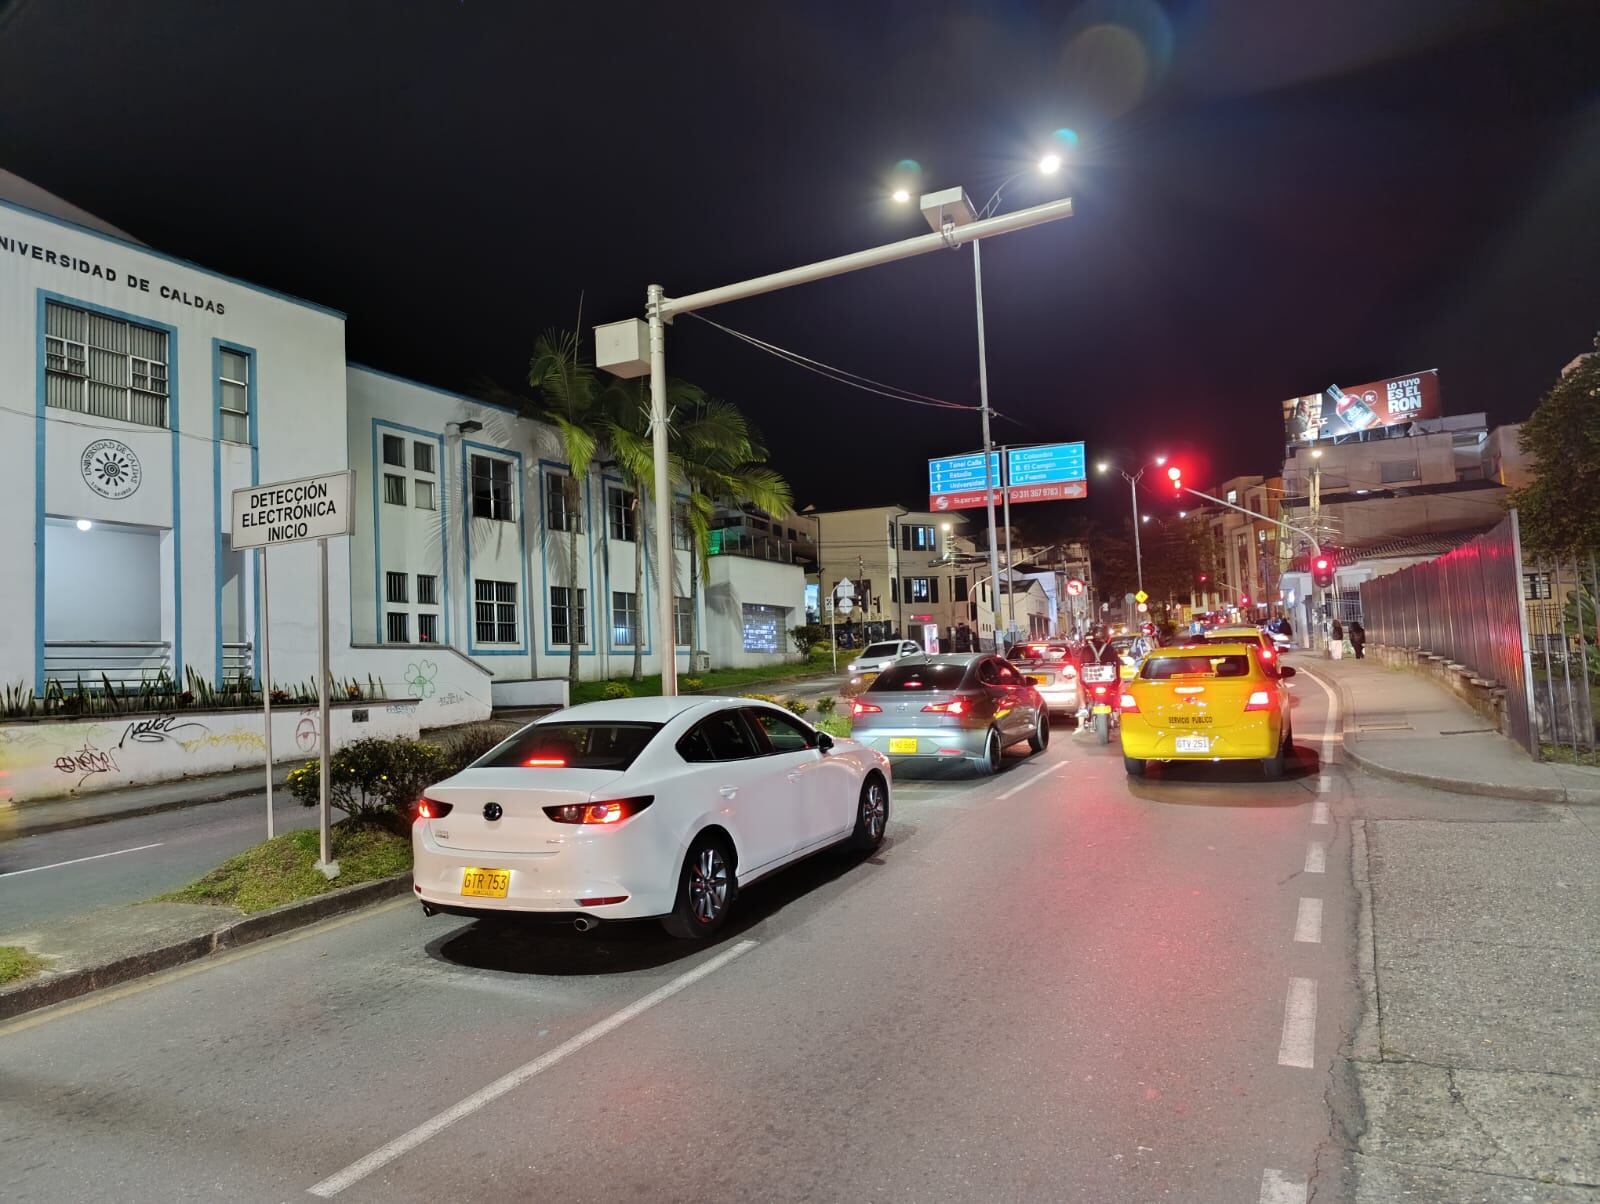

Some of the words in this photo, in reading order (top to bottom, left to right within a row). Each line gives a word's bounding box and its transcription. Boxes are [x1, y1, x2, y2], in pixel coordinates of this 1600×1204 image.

[127, 274, 150, 293] DE
[159, 285, 225, 315] CALDAS
[1386, 383, 1397, 391] LO
[1397, 378, 1420, 388] TUYO
[1387, 389, 1404, 401] ES
[1406, 385, 1421, 397] EL
[1387, 395, 1422, 414] RON
[250, 480, 328, 509] DETECCIÓN
[242, 499, 337, 528] ELECTRÓNICA
[268, 522, 308, 542] INICIO
[1168, 716, 1190, 724] SERVICIO
[464, 873, 485, 889] GTR
[487, 874, 507, 890] 753
